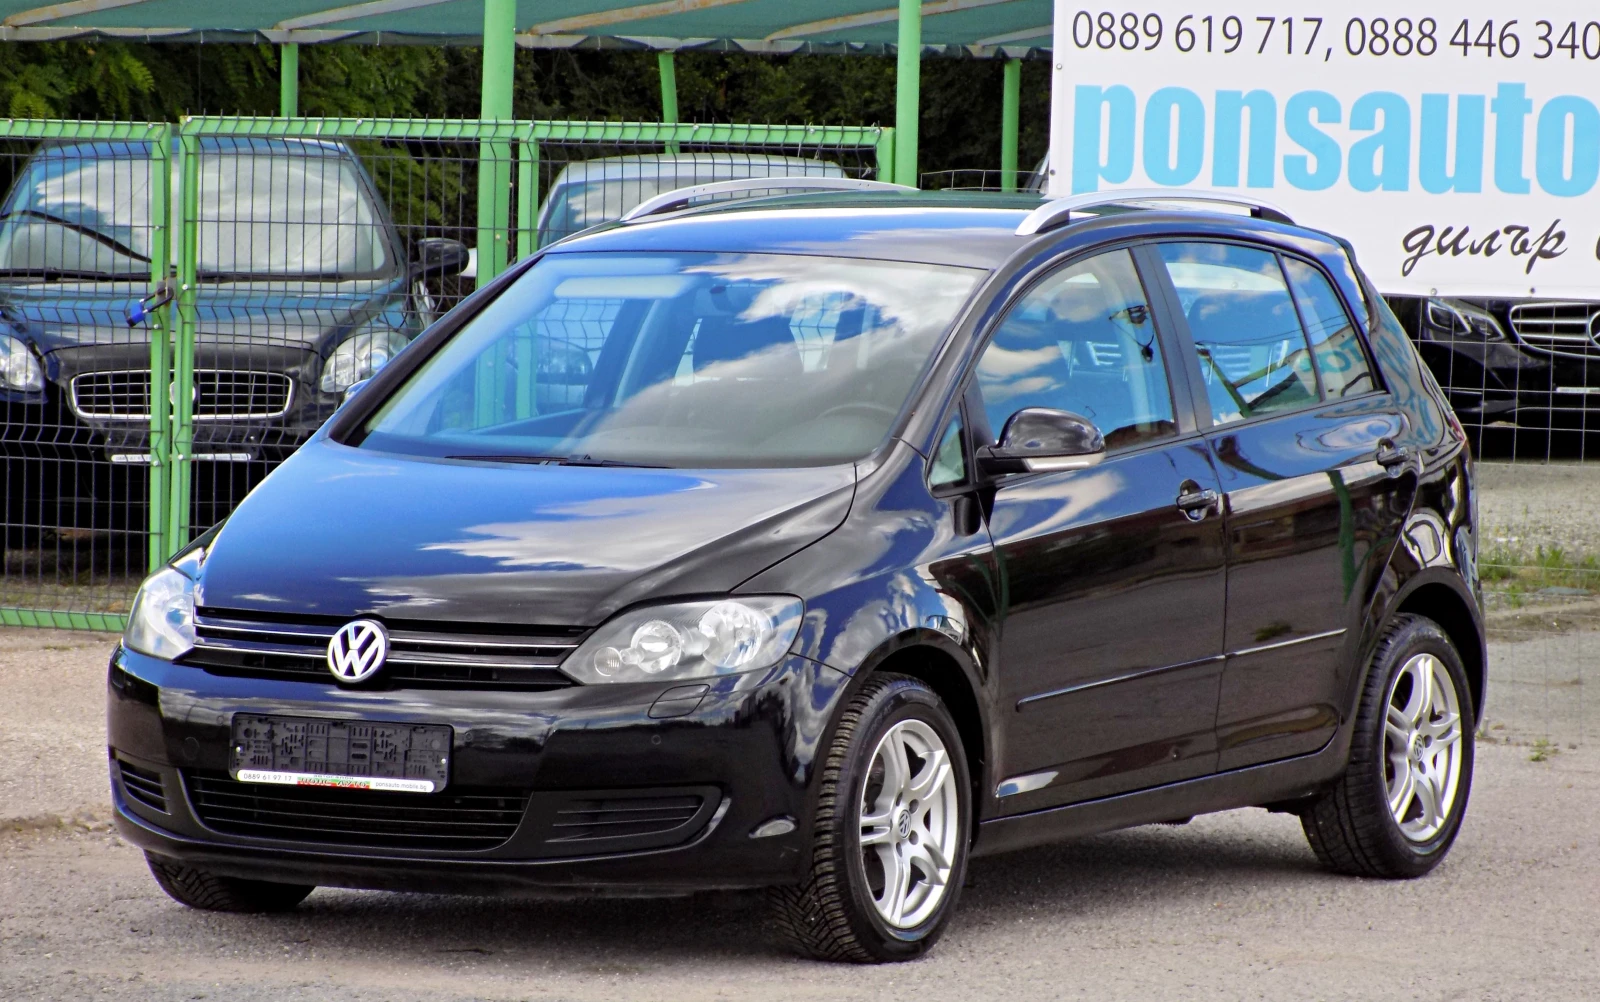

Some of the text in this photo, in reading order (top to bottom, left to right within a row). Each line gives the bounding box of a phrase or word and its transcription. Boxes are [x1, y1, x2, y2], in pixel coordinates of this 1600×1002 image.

[1073, 11, 1600, 62] 0889 619 717, 0888 446 340
[1071, 82, 1600, 197] ponsauto
[1402, 218, 1568, 277] дилър
[327, 619, 388, 682] VW
[243, 772, 261, 780] 0889
